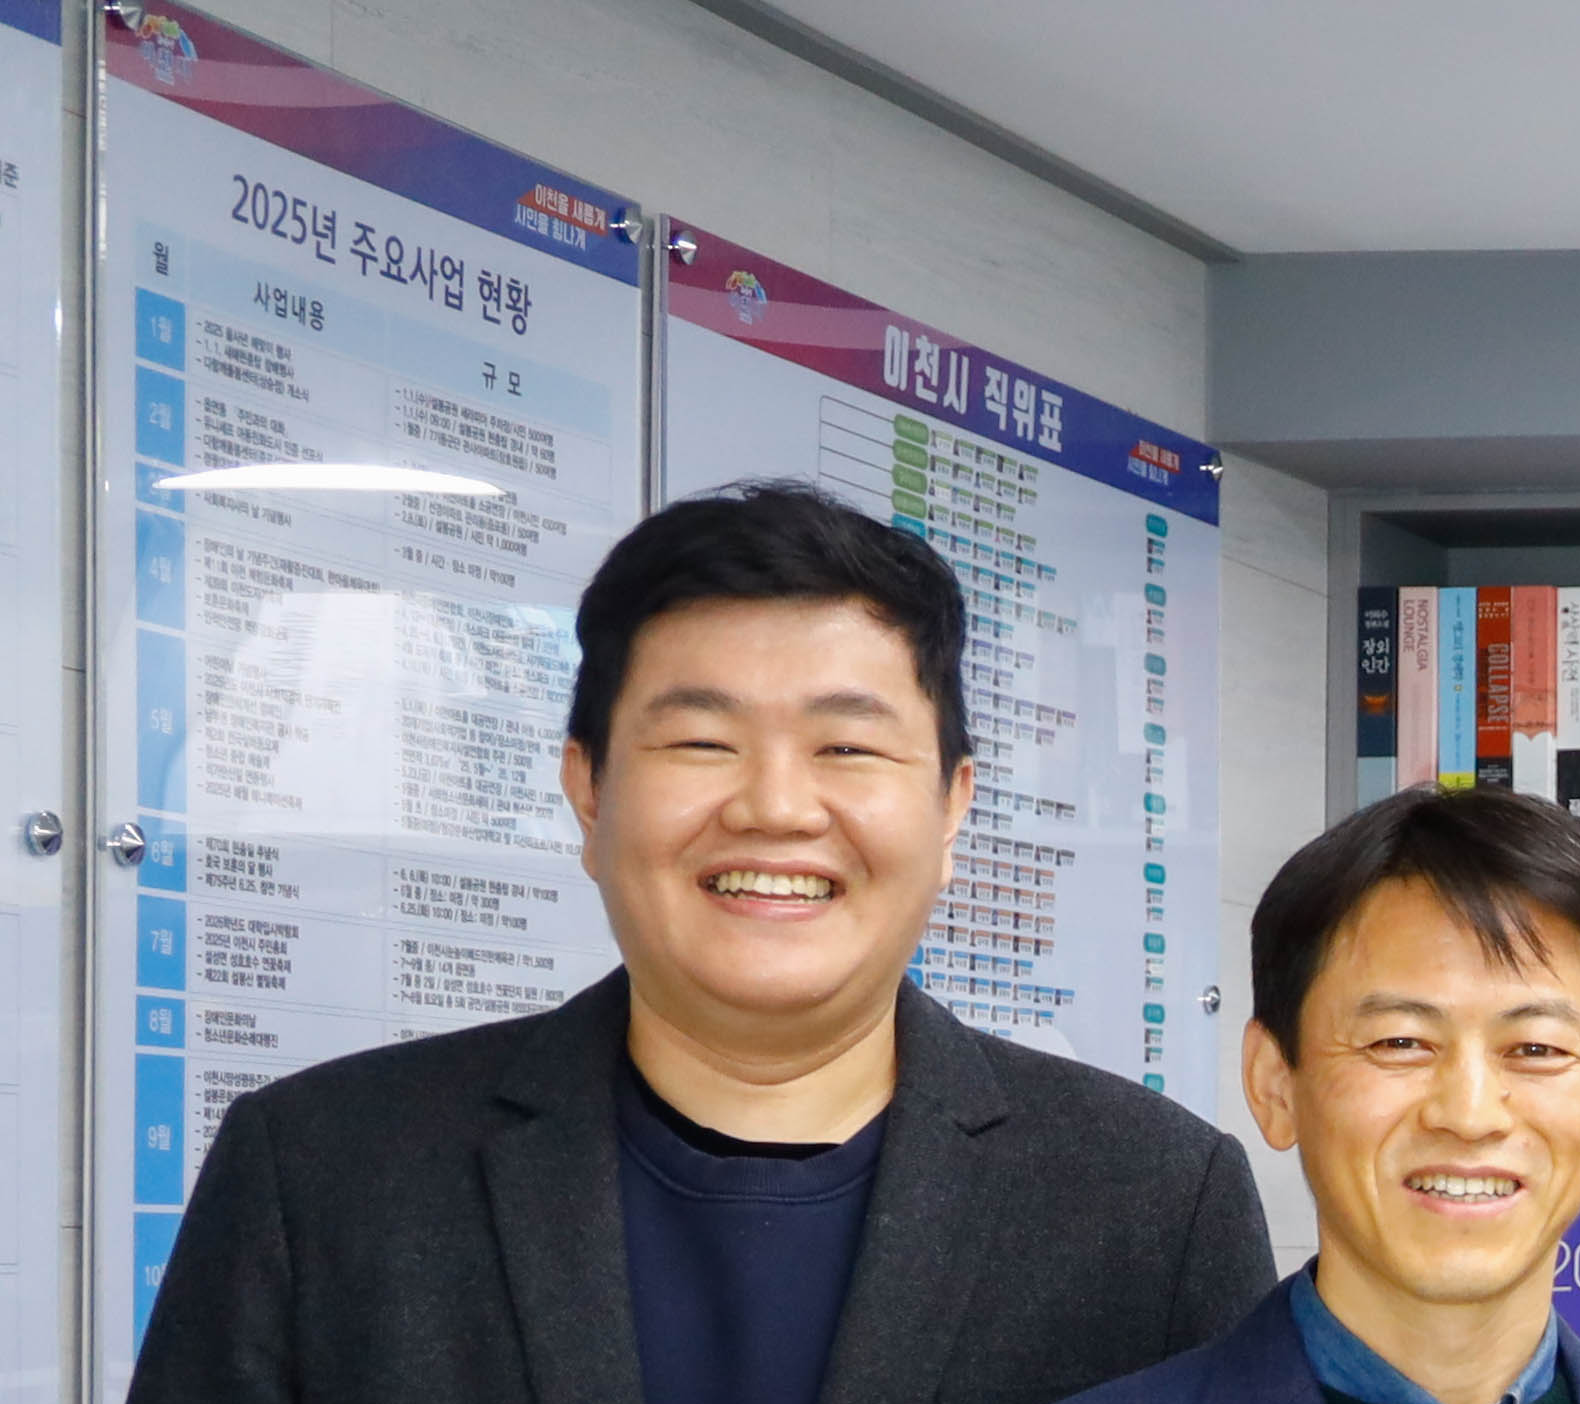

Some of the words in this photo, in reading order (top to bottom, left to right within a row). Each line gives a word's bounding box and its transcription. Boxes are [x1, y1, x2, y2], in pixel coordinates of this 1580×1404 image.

[231, 175, 336, 265] 2025년
[350, 221, 464, 311] 주요사업
[477, 269, 533, 336] 현황
[254, 281, 325, 332] 사업내용
[884, 325, 969, 414] 이천시
[984, 366, 1063, 453] 직위표
[1362, 636, 1390, 655] 장외
[1403, 599, 1415, 652] LOUNGE
[1417, 599, 1429, 670] NOSTALGIA
[1361, 656, 1390, 674] 인간
[1488, 643, 1509, 724] COLLAPSE
[1562, 649, 1580, 683] 사전
[151, 708, 173, 735] 5월
